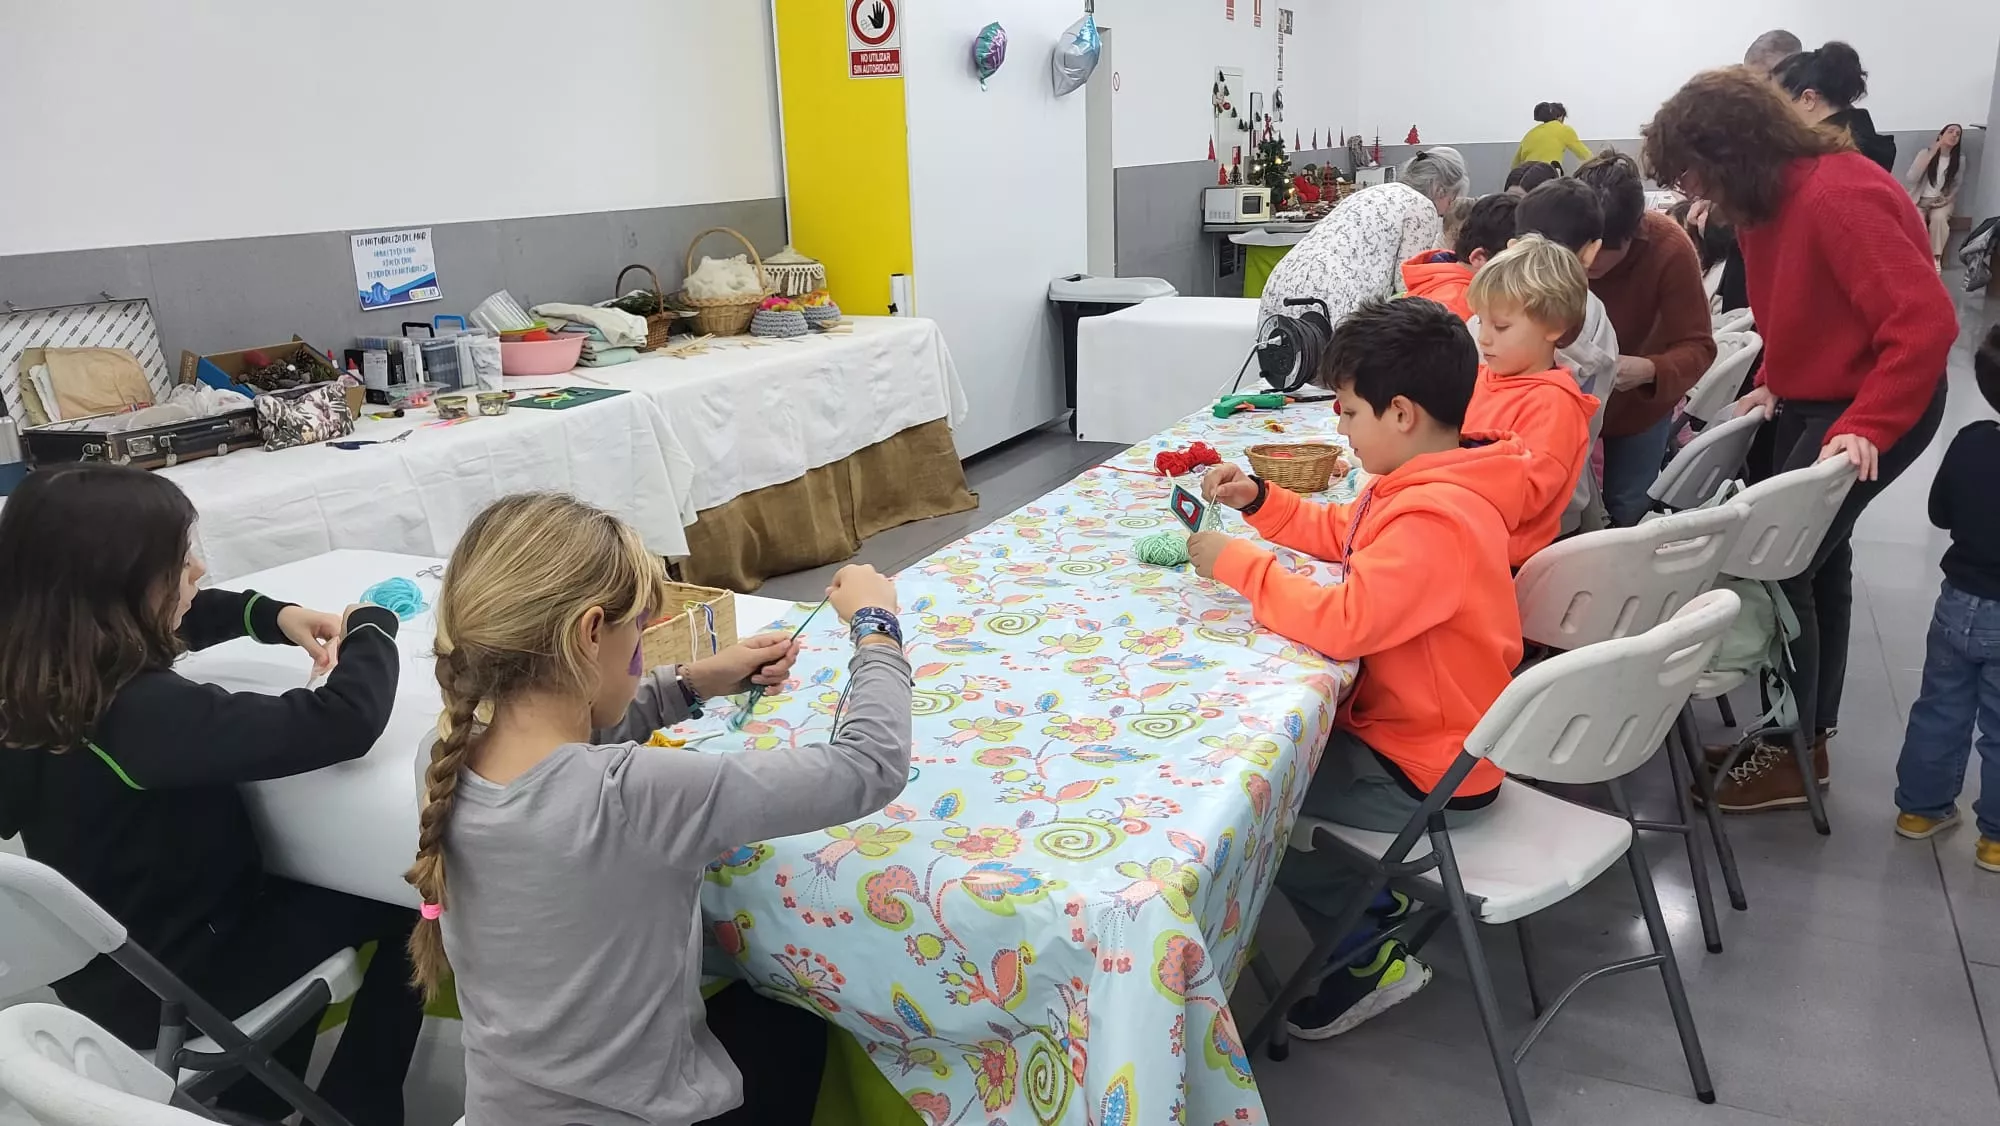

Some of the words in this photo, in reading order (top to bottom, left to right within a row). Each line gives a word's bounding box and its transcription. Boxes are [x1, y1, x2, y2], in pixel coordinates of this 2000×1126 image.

[860, 54, 868, 62] NO
[869, 53, 890, 62] UTILIZAR
[854, 65, 863, 74] SIN
